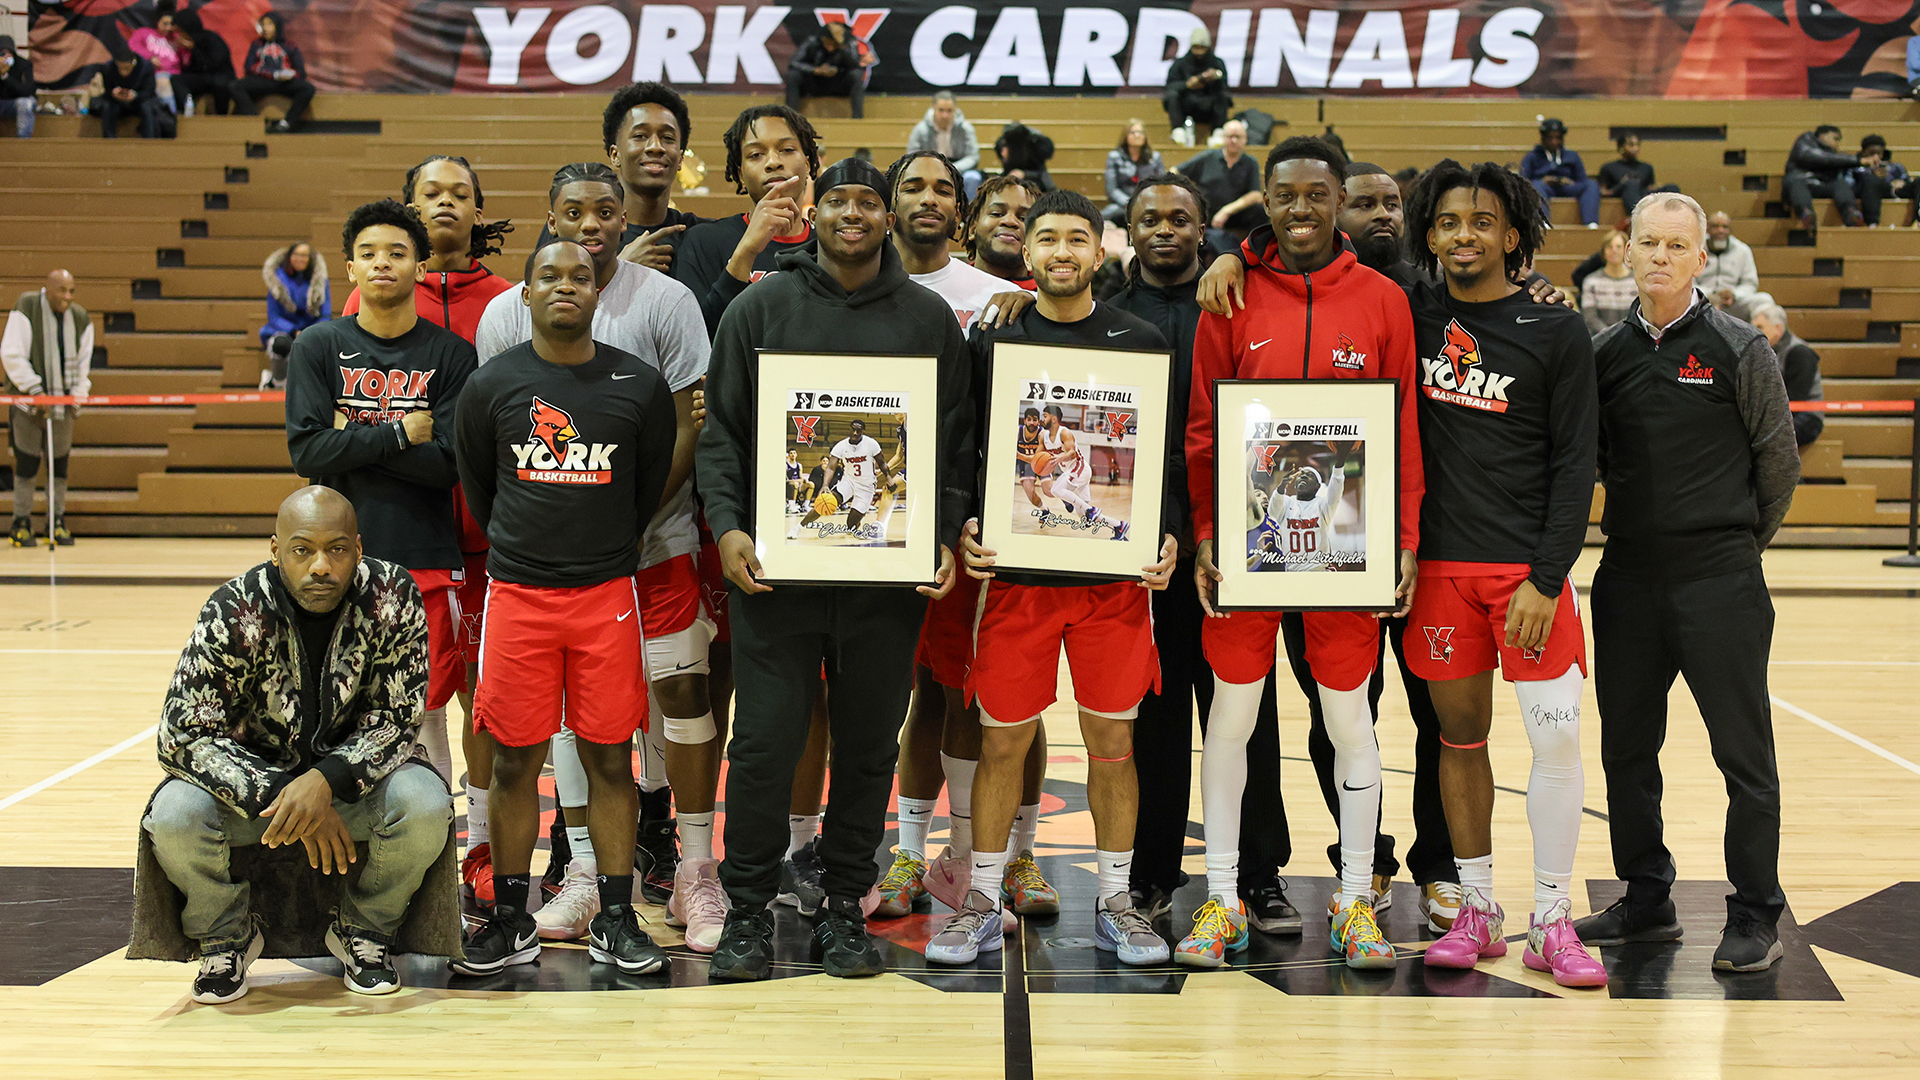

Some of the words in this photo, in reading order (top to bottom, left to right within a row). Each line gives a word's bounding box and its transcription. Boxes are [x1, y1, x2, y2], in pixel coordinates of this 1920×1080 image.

[472, 5, 792, 86] YORK
[909, 5, 1544, 89] CARDINALS
[1332, 349, 1367, 366] YORK
[1421, 357, 1516, 402] YORK
[1678, 367, 1714, 378] YORK
[340, 365, 436, 399] YORK
[1677, 377, 1714, 385] CARDINALS
[835, 396, 901, 408] BASKETBALL
[1067, 388, 1132, 404] BASKETBALL
[1431, 389, 1492, 409] BASKETBALL
[1293, 425, 1359, 436] BASKETBALL
[510, 442, 619, 471] YORK
[529, 471, 598, 483] BASKETBALL
[853, 464, 862, 477] 3
[1286, 517, 1320, 530] YORK
[1290, 530, 1316, 553] 00
[1261, 550, 1307, 564] Michael
[1308, 549, 1366, 568] Litchfield
